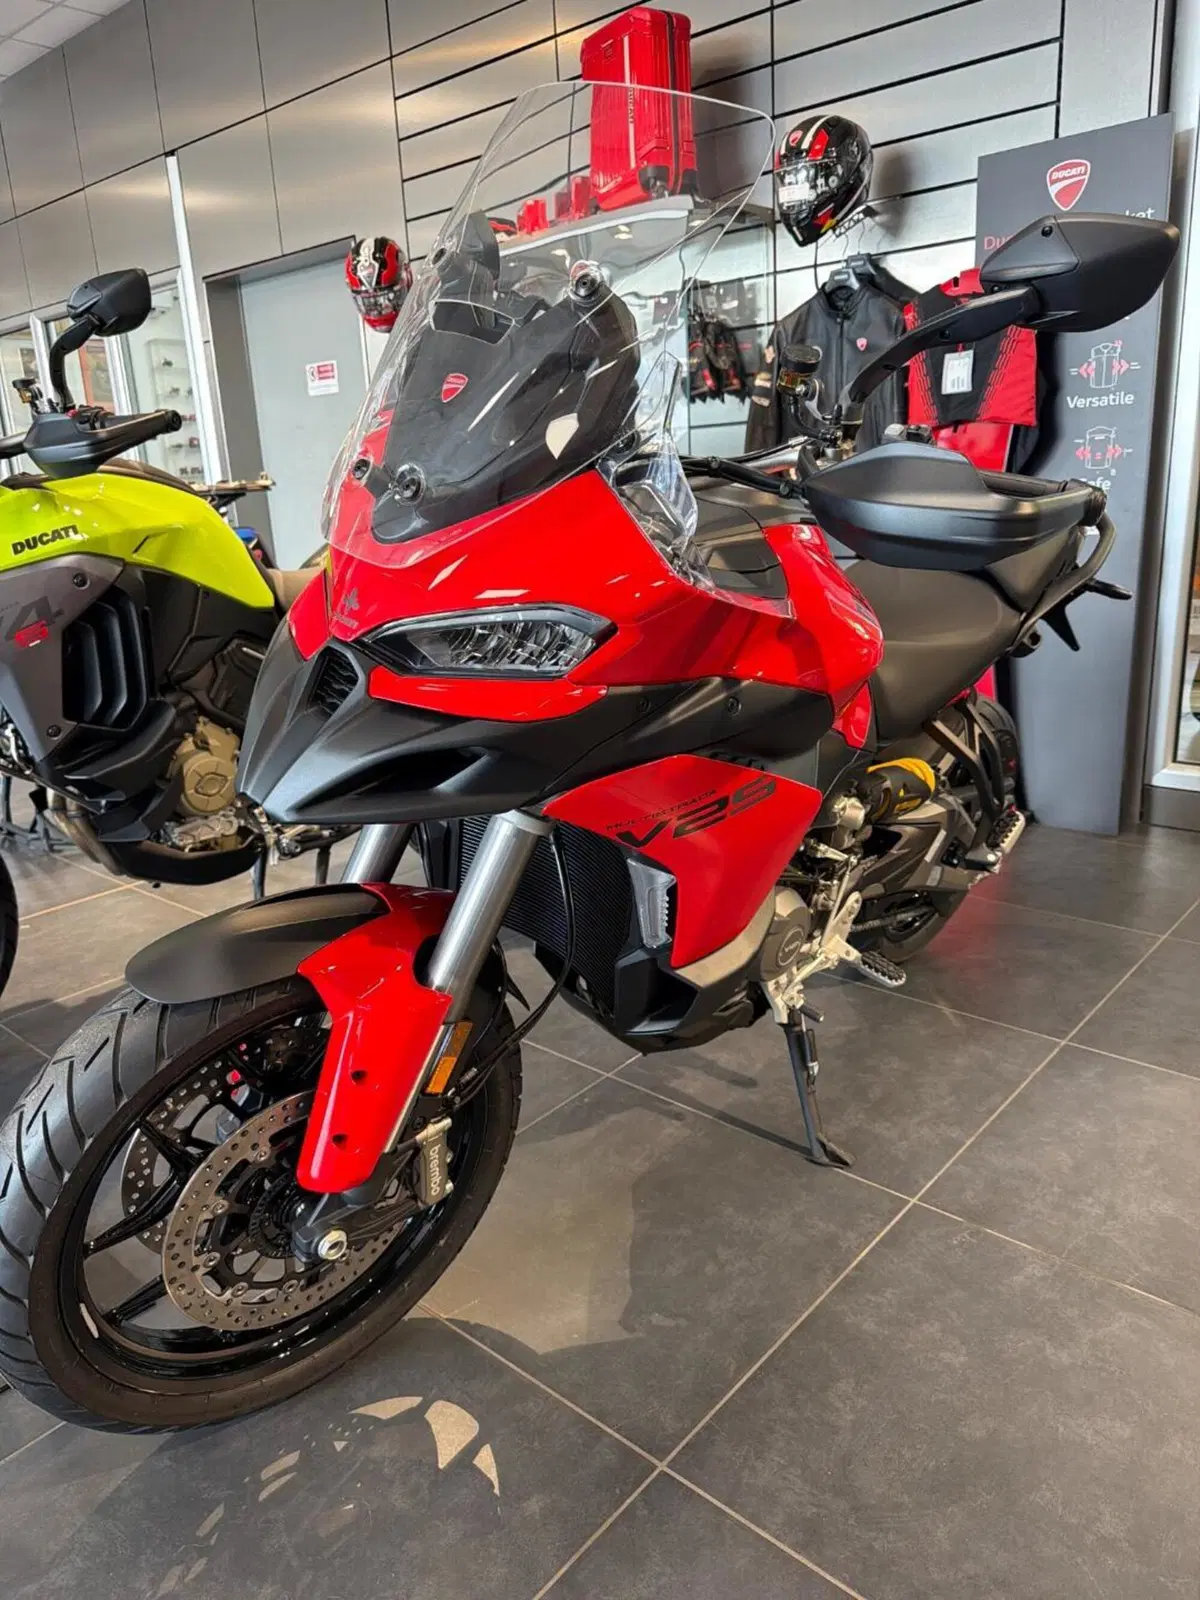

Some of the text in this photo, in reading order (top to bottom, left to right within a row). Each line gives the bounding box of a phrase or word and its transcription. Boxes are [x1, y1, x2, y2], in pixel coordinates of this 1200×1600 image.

[1050, 166, 1086, 180] DUCATI
[984, 235, 1014, 250] Du
[1066, 391, 1134, 408] Versatile
[11, 524, 79, 555] DUCATI
[616, 775, 776, 848] V2S
[430, 1143, 442, 1196] brembo
